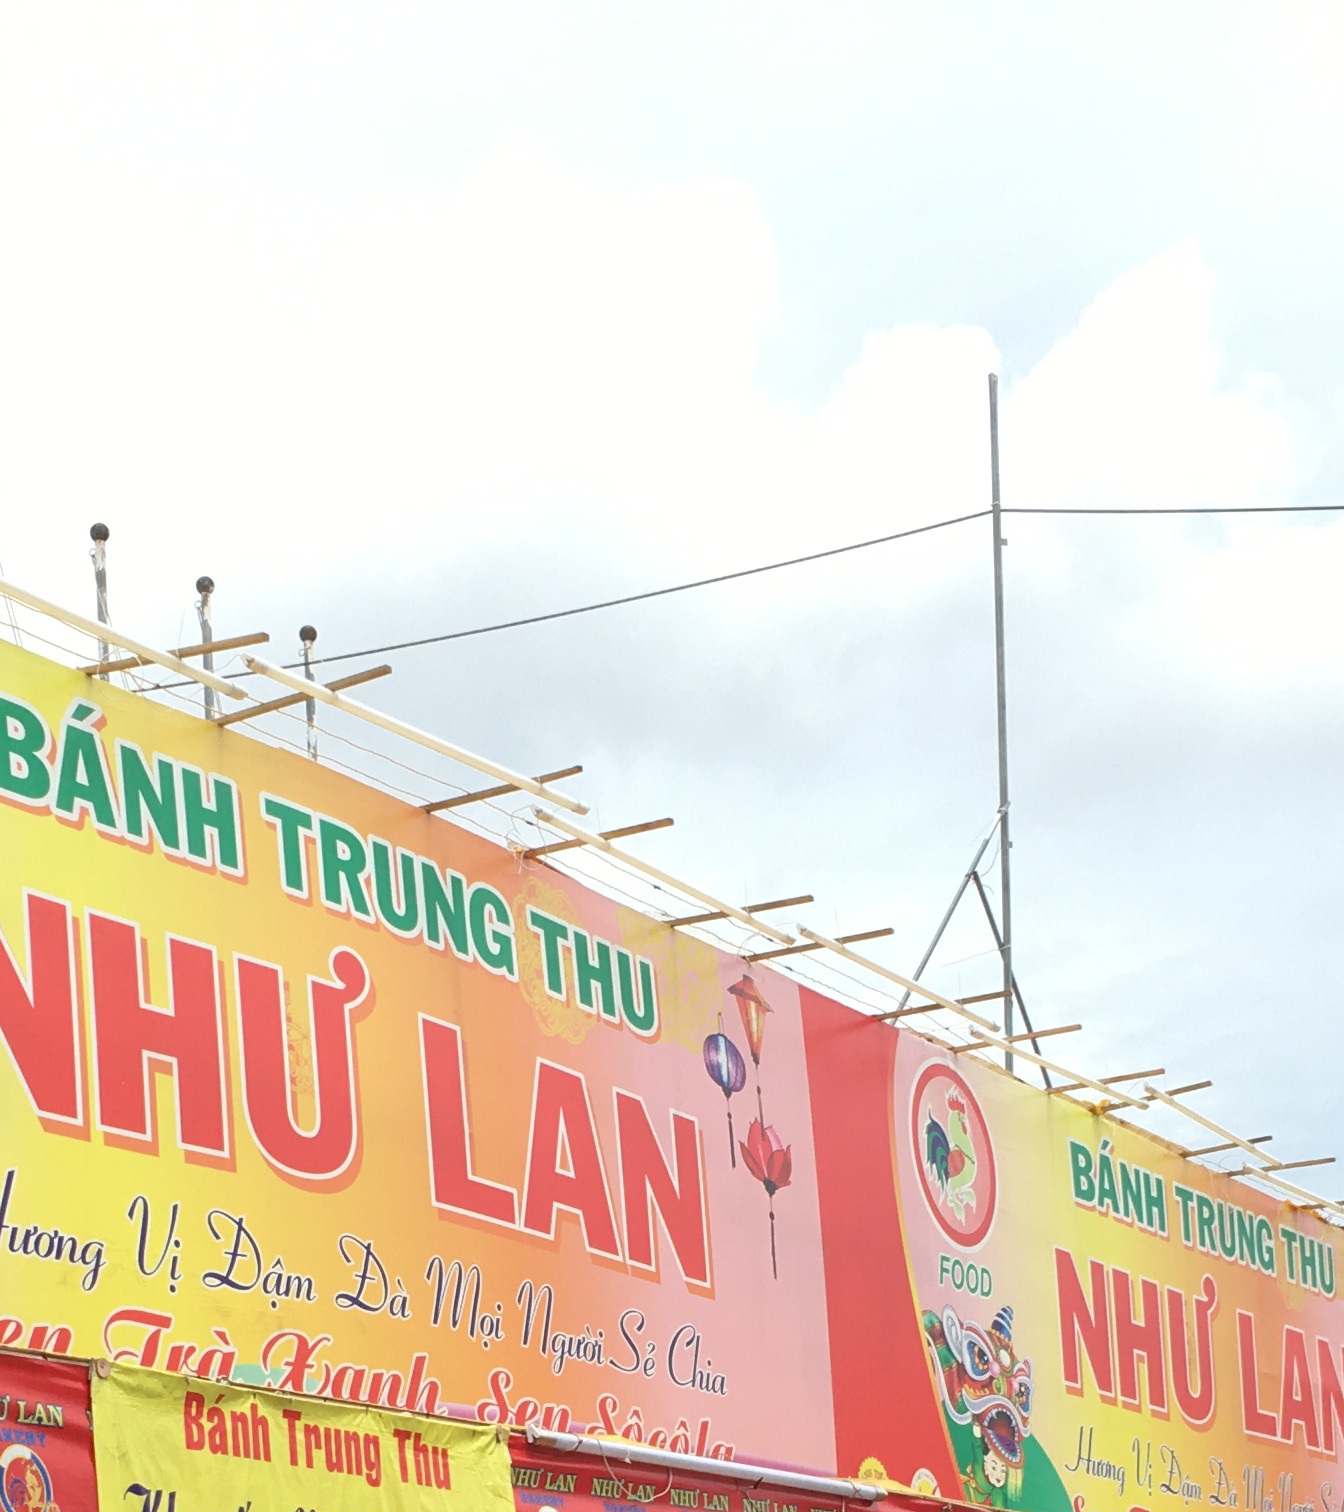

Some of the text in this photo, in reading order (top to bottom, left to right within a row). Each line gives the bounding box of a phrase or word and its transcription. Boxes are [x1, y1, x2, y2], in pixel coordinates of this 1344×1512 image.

[262, 794, 518, 981] TRUNG
[528, 908, 660, 1037] THU
[416, 1011, 714, 1287] LAN
[938, 1254, 994, 1299] FOOD
[1067, 1138, 1336, 1300] BÁNH TRUNG THU
[127, 1194, 183, 1293] Vị
[206, 1208, 319, 1311] Đậm
[337, 1234, 413, 1320] Đà
[425, 1255, 506, 1350] Mọi
[516, 1279, 606, 1380] Người
[666, 1322, 731, 1399] Chia
[1052, 1247, 1219, 1426] NHƯ
[16, 1400, 64, 1428] LAN
[102, 1306, 238, 1382] Trà
[475, 1370, 573, 1440] Sen
[183, 1391, 452, 1490] Bánh Trung Thu
[702, 1492, 730, 1512] LAN
[1064, 1425, 1126, 1496] Hương
[1131, 1437, 1154, 1497] Vị
[1160, 1444, 1202, 1507] Đậm
[1209, 1456, 1238, 1509] Đà
